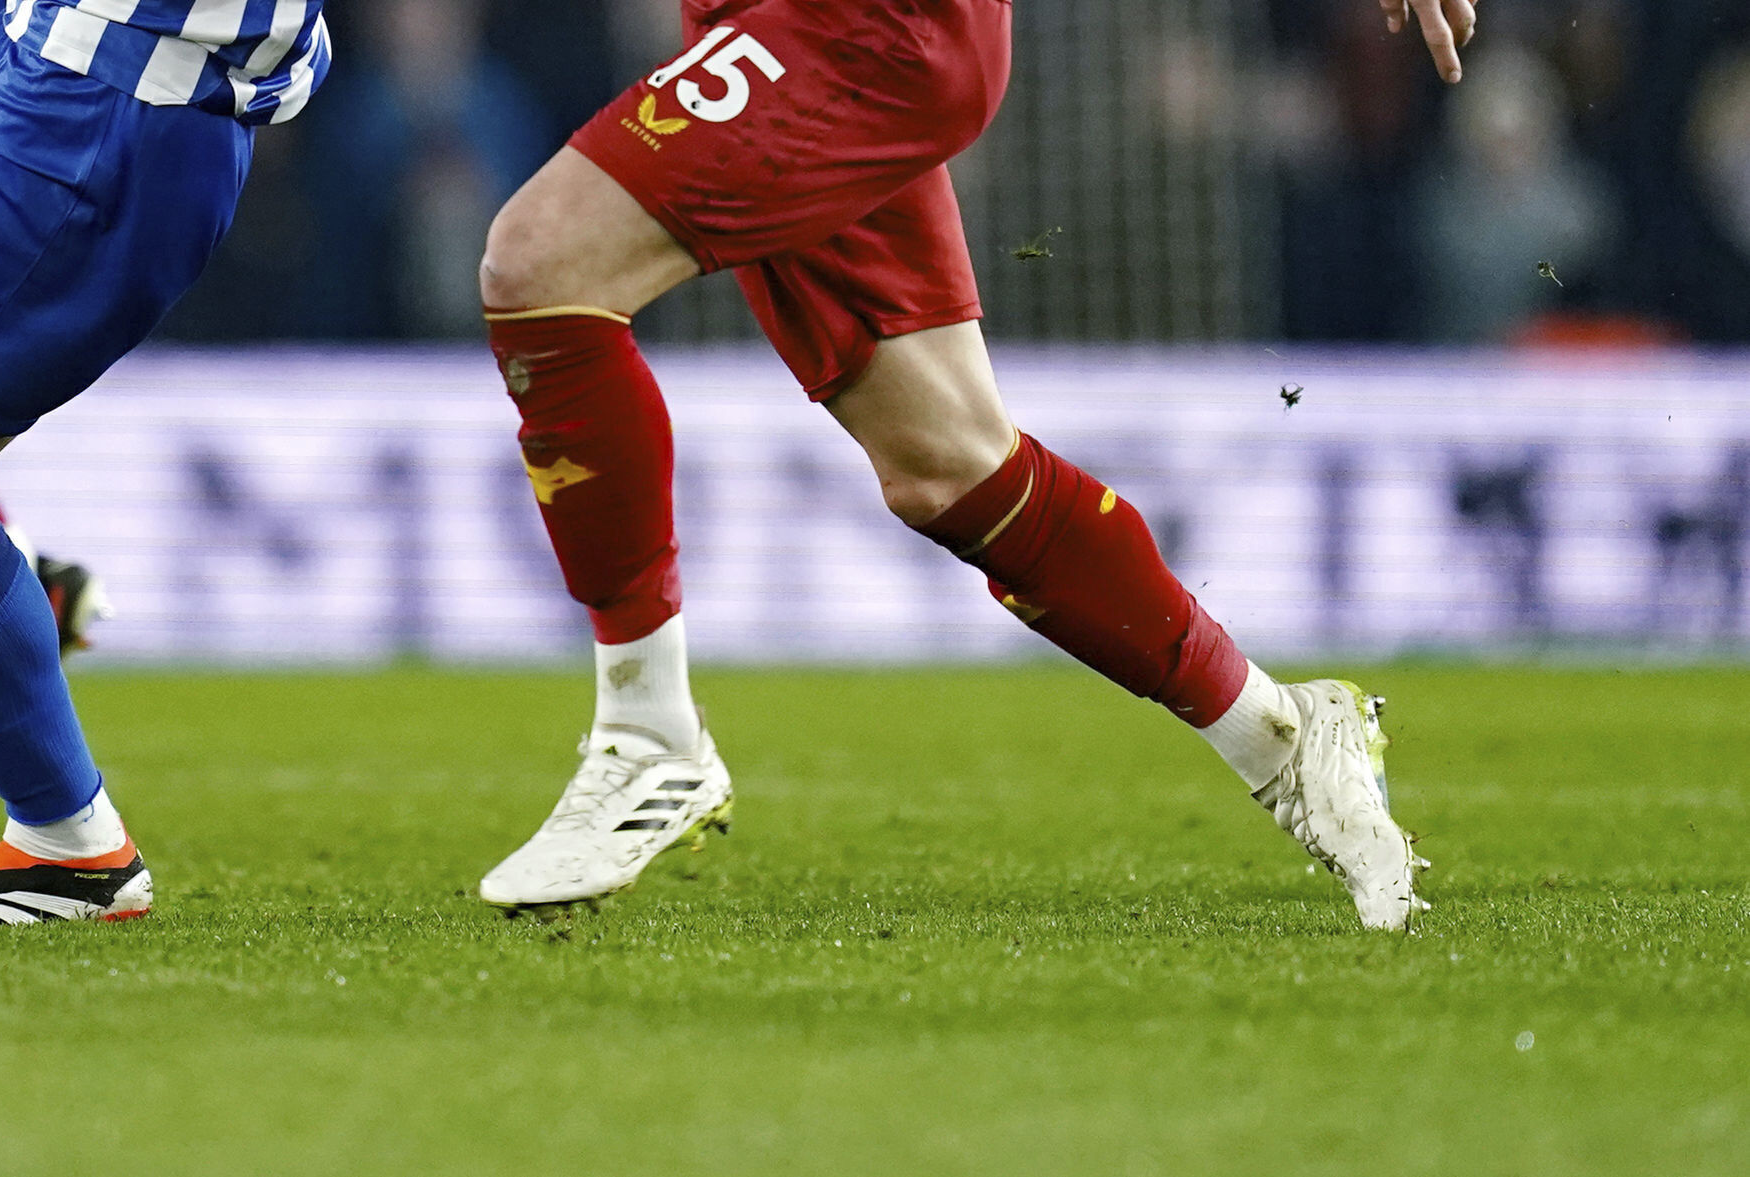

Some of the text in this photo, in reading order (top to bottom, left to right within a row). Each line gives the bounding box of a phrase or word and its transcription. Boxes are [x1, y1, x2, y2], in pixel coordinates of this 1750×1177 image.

[647, 26, 787, 123] 15
[620, 118, 662, 152] CASTORE
[1331, 722, 1339, 745] COPA
